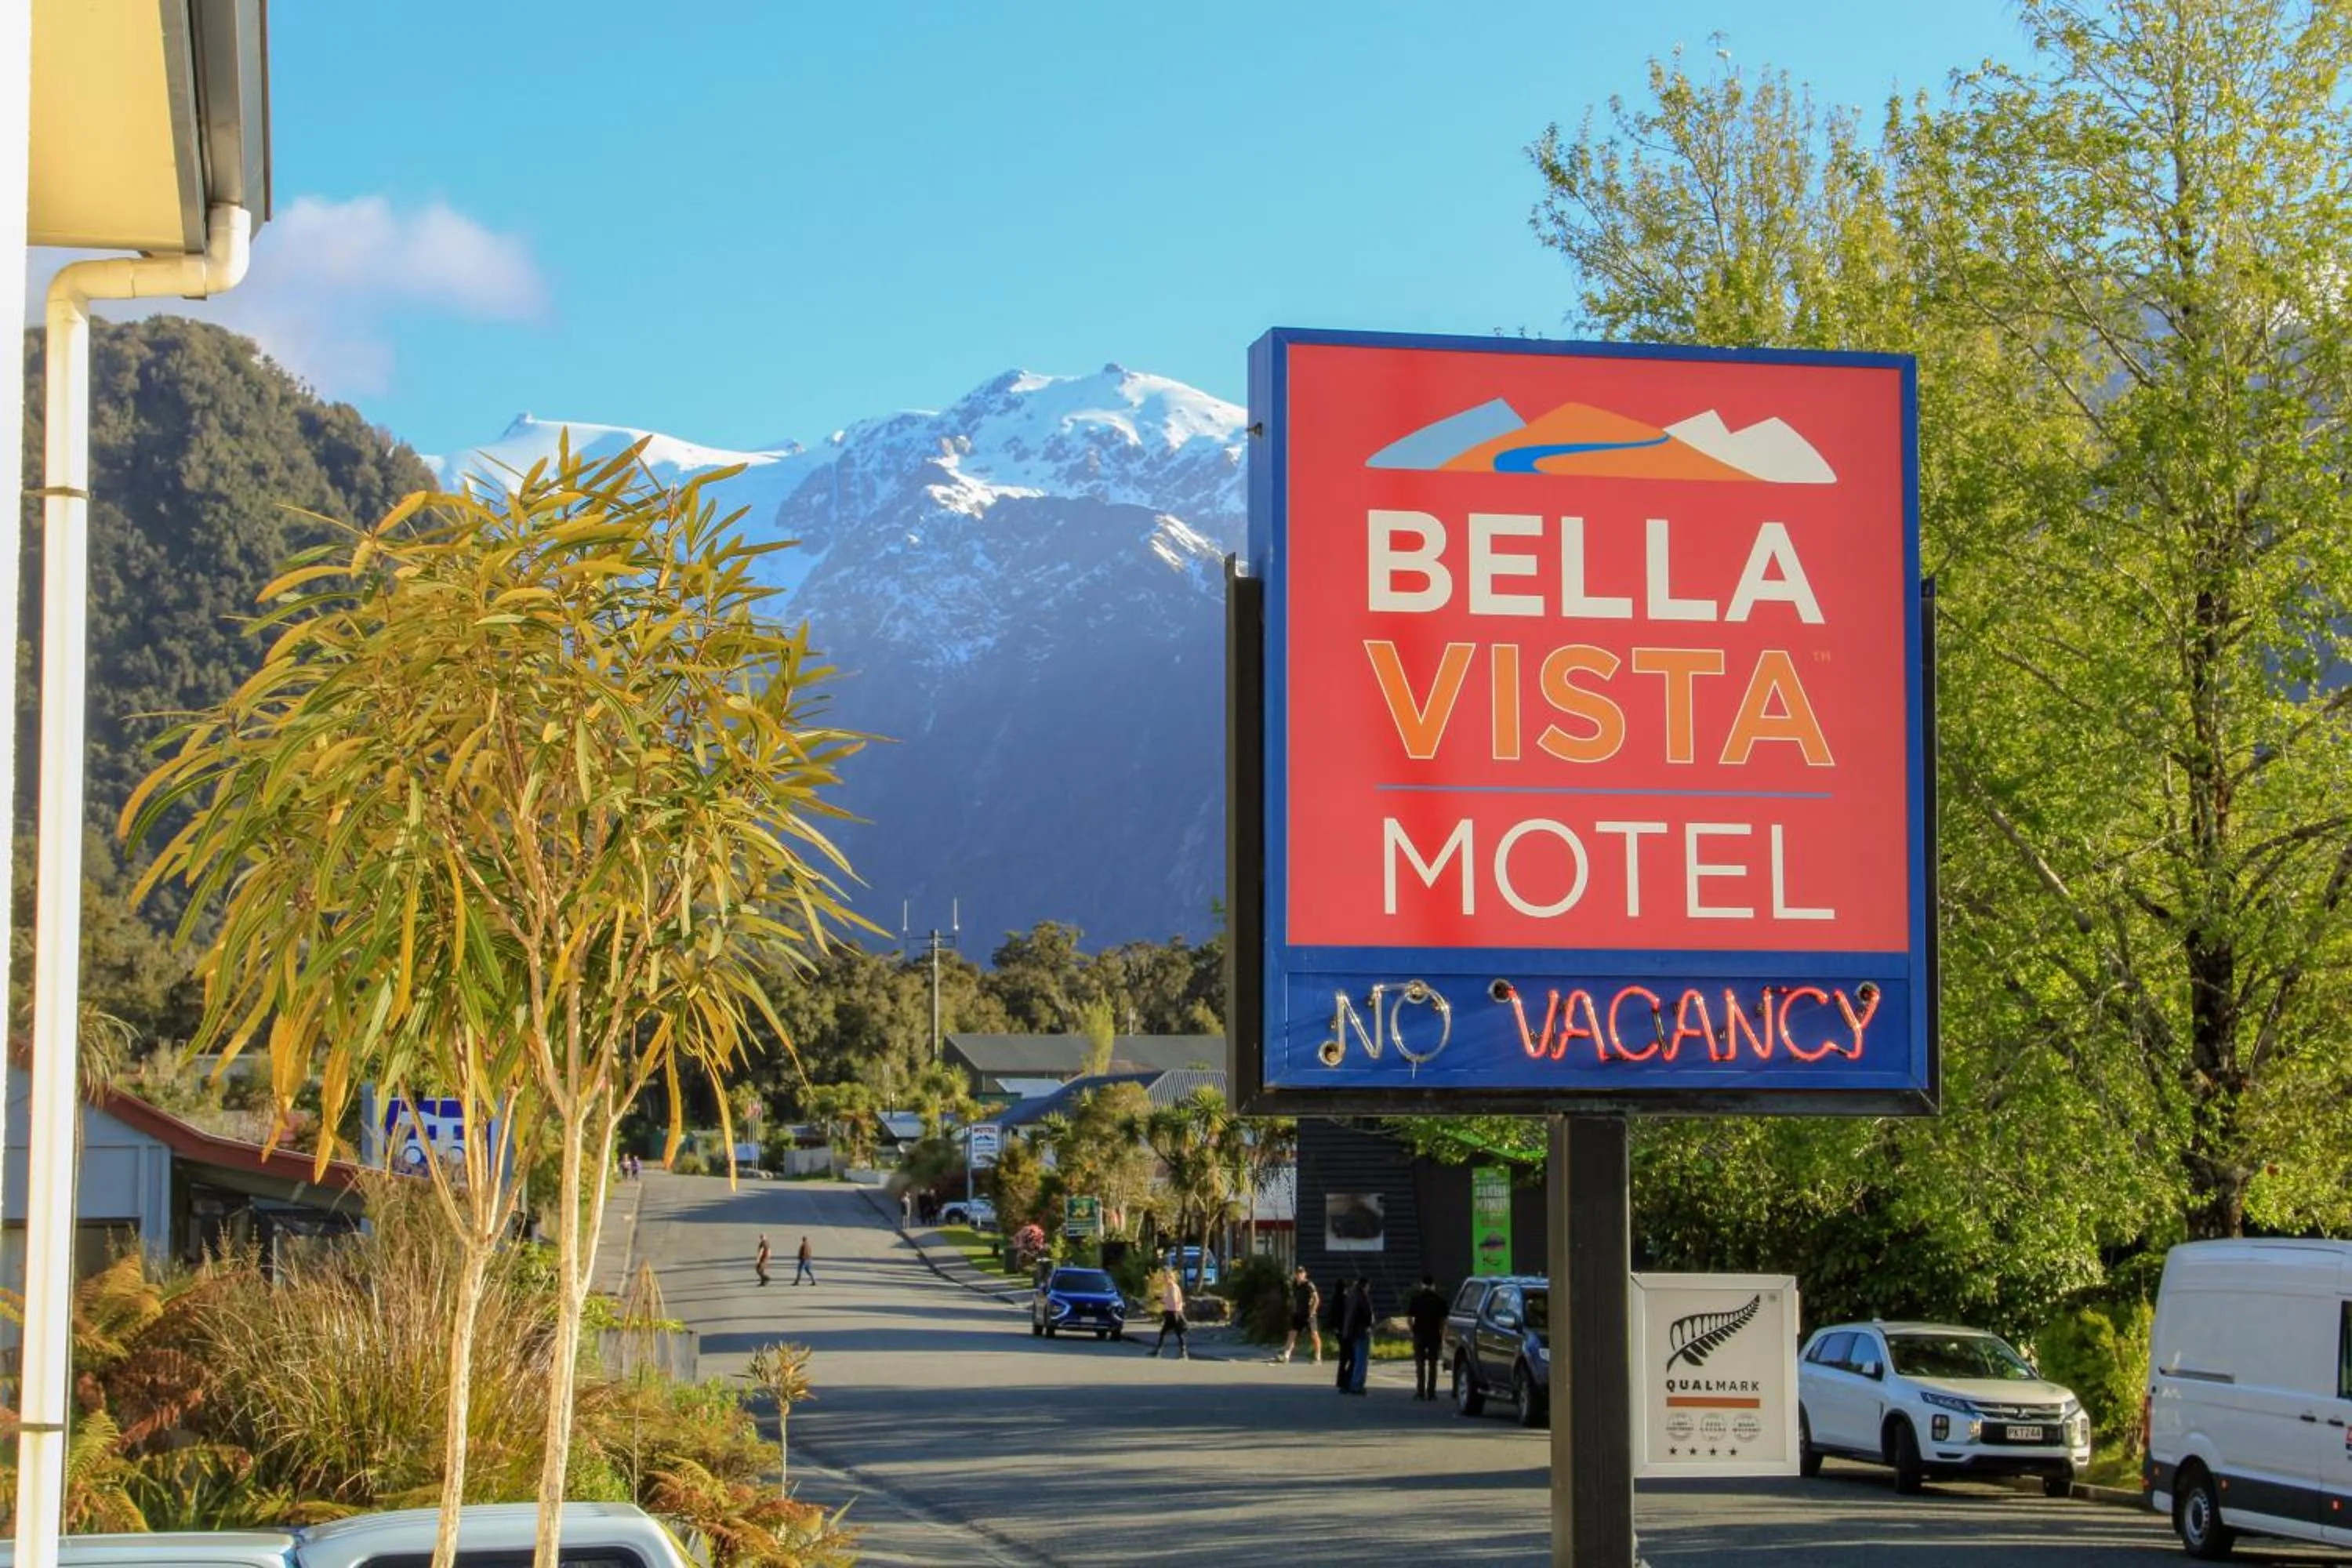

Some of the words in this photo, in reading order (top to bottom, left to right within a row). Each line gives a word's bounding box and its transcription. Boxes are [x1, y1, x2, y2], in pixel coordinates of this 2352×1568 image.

[1367, 510, 1825, 625] BELLA
[1363, 639, 1836, 767] VISTA
[1382, 817, 1835, 920] MOTEL
[1325, 982, 1451, 1063] NO
[1507, 985, 1880, 1062] VACANCY
[1666, 1379, 1759, 1393] QUALMARK
